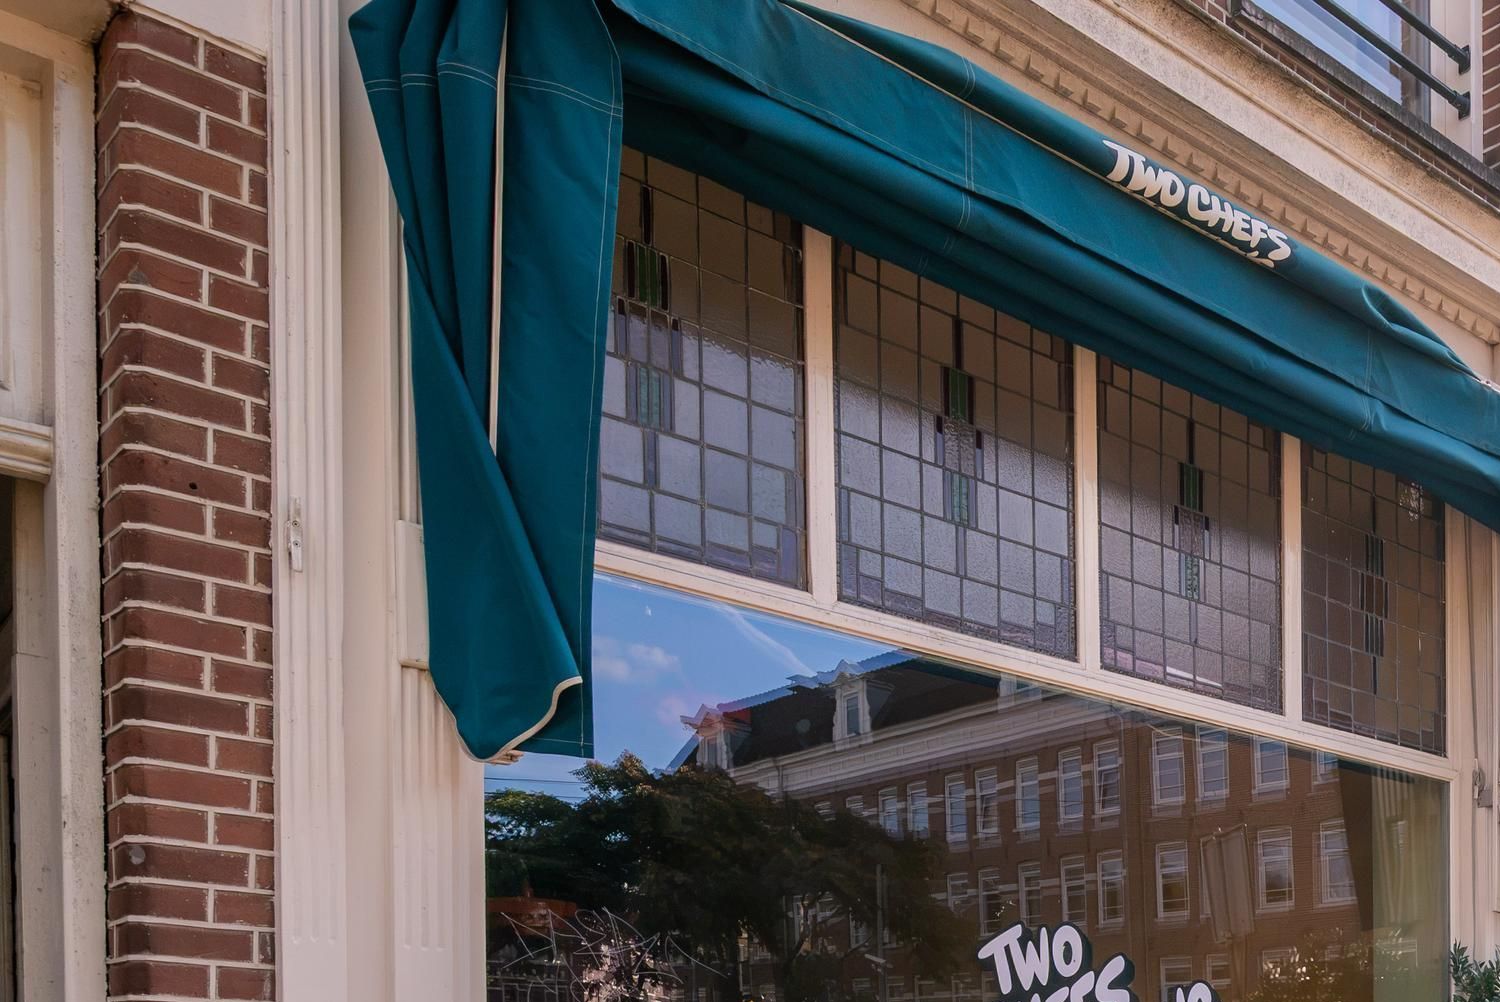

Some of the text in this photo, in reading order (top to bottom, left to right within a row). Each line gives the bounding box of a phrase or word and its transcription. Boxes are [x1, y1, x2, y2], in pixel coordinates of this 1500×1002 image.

[1103, 139, 1292, 261] TWO CHEFS
[978, 924, 1083, 994] TWO
